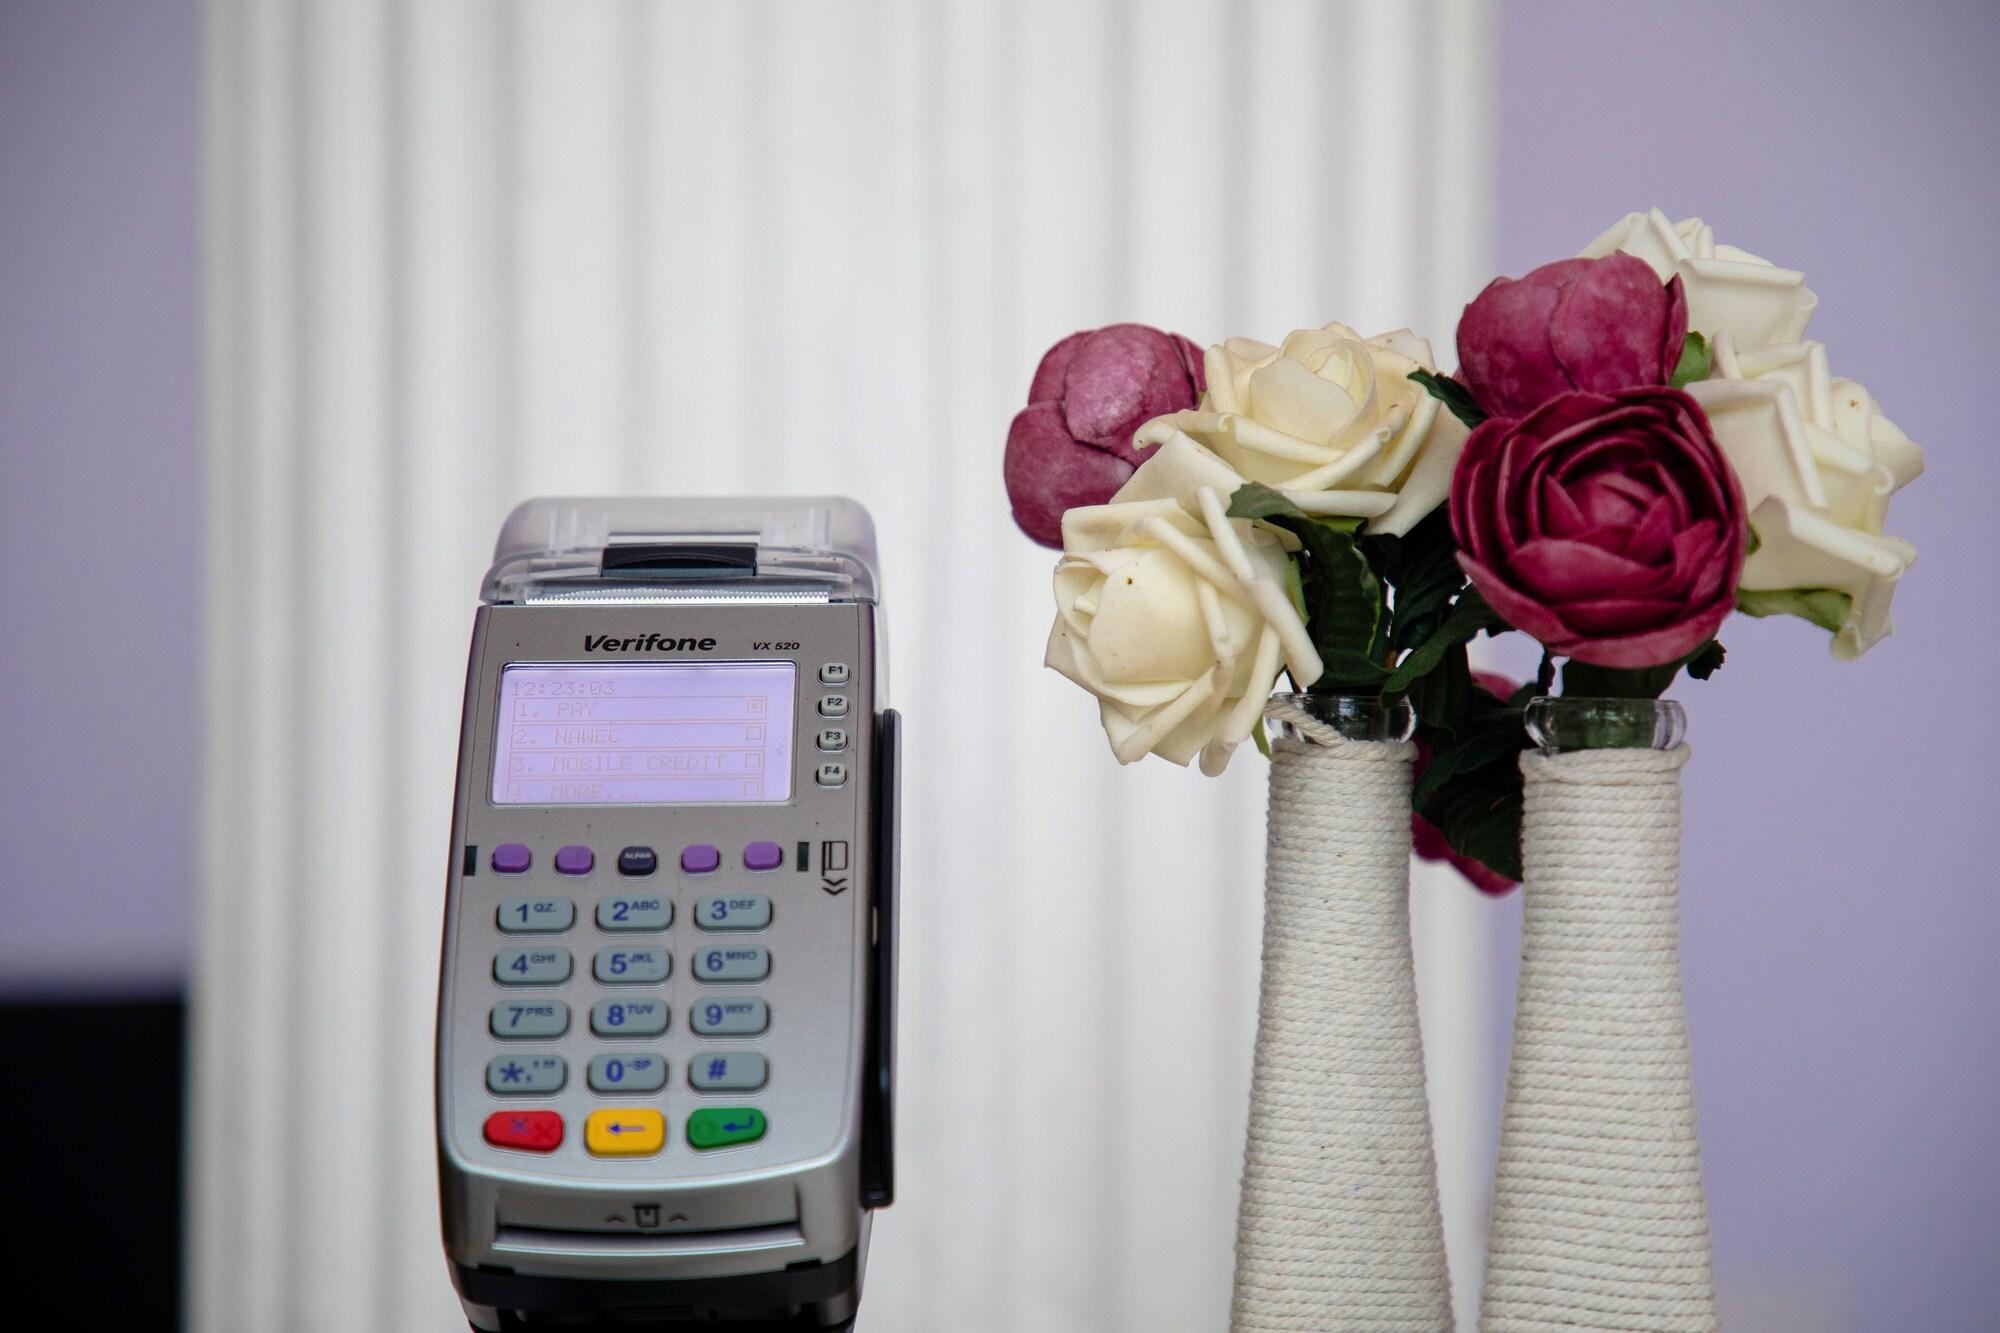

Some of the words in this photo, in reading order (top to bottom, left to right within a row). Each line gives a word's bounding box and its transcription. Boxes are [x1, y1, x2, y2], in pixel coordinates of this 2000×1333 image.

[584, 634, 717, 652] Verifone
[753, 642, 772, 650] VX
[775, 642, 800, 650] 520
[828, 666, 843, 674] F1
[511, 681, 615, 696] 12:23:03
[519, 703, 538, 717] 1.
[556, 702, 597, 717] PAY
[827, 698, 842, 706] F2
[514, 729, 536, 744] 2.
[554, 728, 622, 744] NAWEC
[825, 732, 841, 740] F3
[511, 756, 534, 772] 3.
[552, 755, 633, 771] MOBILE
[646, 754, 728, 770] CREDIT
[824, 767, 840, 775] F4
[516, 903, 529, 923] 1
[612, 901, 629, 922] 2
[630, 901, 660, 911] ABC
[711, 900, 728, 920] 3
[730, 901, 756, 910] DEF
[511, 954, 528, 975] 4
[610, 953, 627, 975] 5
[628, 953, 654, 963] JKL
[706, 951, 724, 972] 6
[726, 951, 758, 961] MNO
[509, 1007, 525, 1028] 7
[526, 1007, 553, 1017] PRS
[607, 1004, 625, 1027] 8
[627, 1004, 655, 1015] TUV
[705, 1004, 723, 1026] 9
[606, 1059, 624, 1082] 0
[708, 1059, 727, 1080] #
